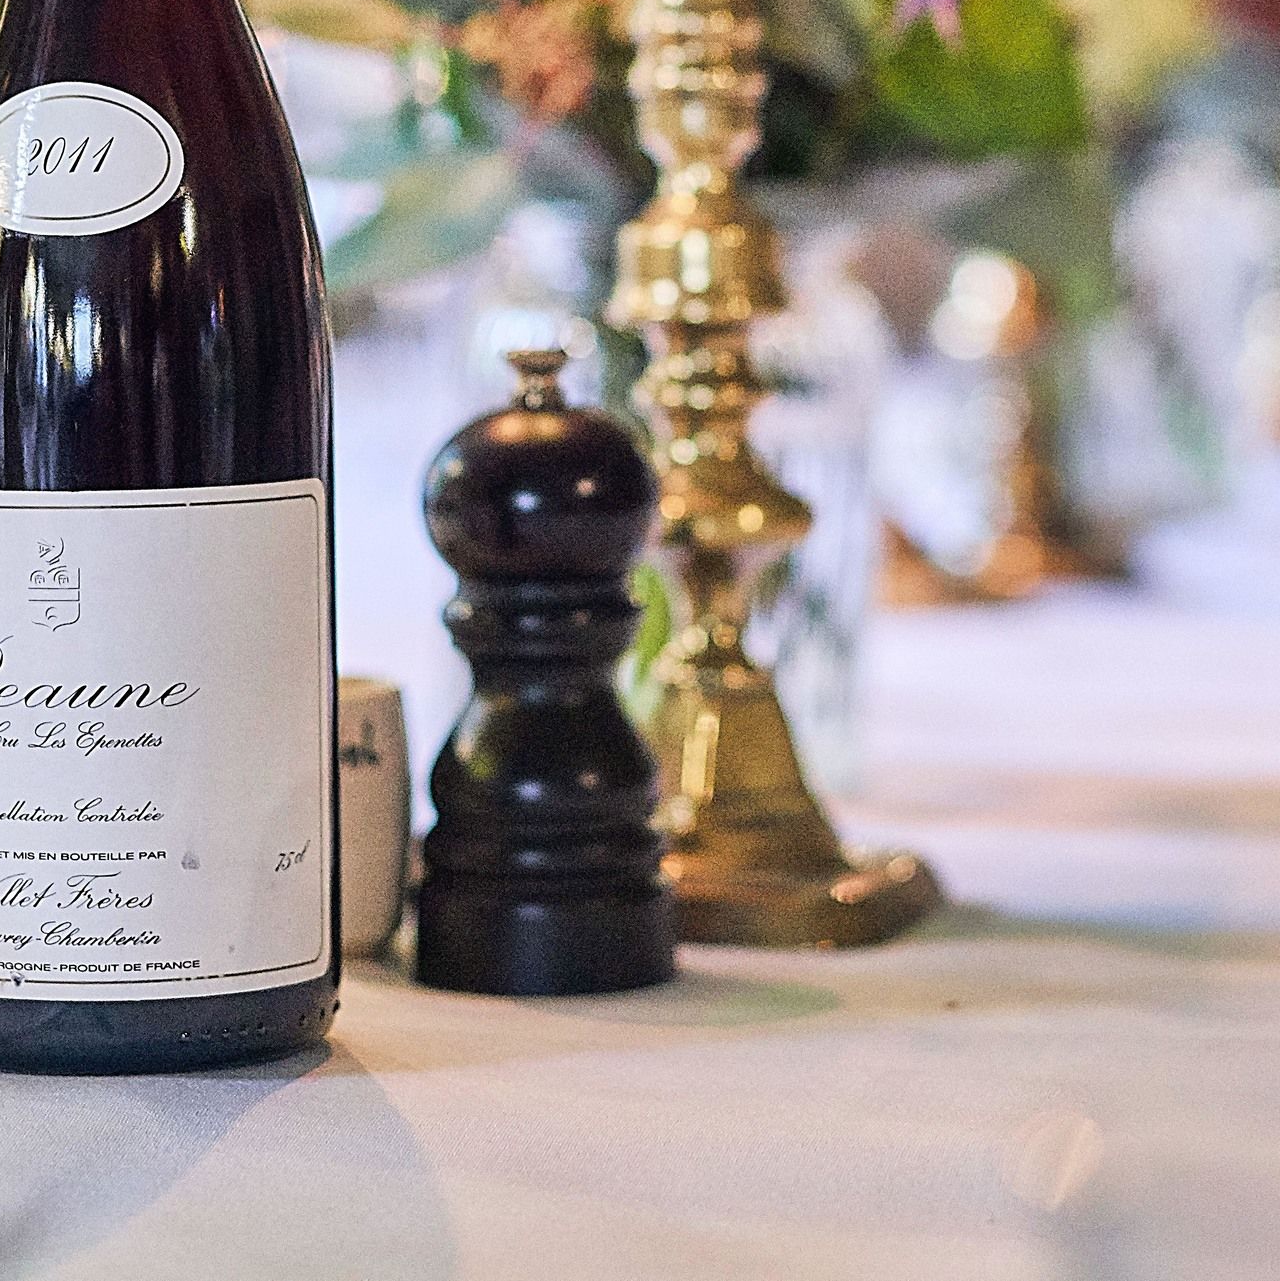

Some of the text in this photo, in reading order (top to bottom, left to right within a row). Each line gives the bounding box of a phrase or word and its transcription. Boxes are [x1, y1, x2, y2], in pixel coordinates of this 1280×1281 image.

[27, 135, 115, 176] 2011
[27, 720, 68, 750] Les
[75, 720, 164, 758] Epenottes
[73, 797, 165, 823] Contrôlée
[13, 851, 36, 861] MIS
[39, 852, 57, 862] EN
[60, 852, 136, 862] BOUTEILLE
[138, 850, 167, 861] PAR
[56, 870, 155, 910] Frères
[123, 963, 142, 972] DE
[145, 960, 201, 971] FRANCE
